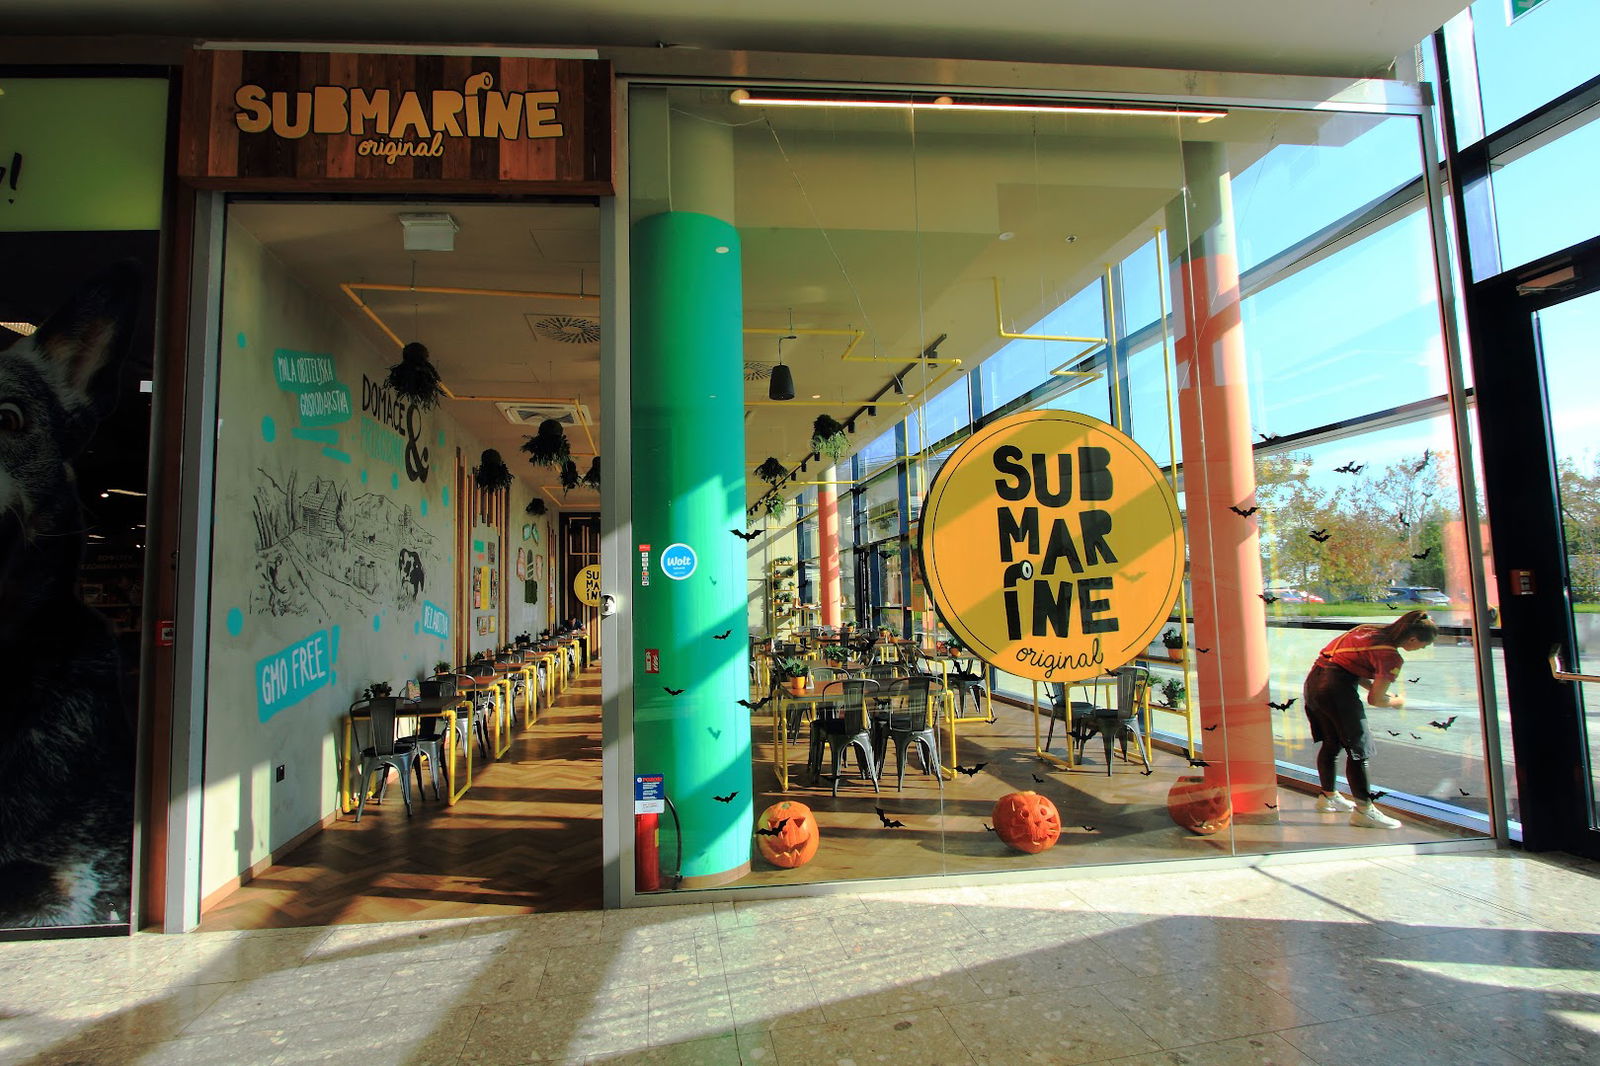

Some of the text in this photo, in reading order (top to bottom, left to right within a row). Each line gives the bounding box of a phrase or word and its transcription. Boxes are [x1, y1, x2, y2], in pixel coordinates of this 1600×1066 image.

[235, 71, 564, 139] SUBMARINE
[358, 131, 444, 165] original
[297, 357, 333, 386] OBITELJSKA
[300, 390, 350, 417] GOSPODARSTVA
[993, 445, 1113, 507] SUB
[667, 556, 691, 567] Wolt
[997, 507, 1118, 575] MAR
[1003, 560, 1119, 641] INE
[1016, 637, 1103, 678] original
[261, 661, 288, 706] GMO
